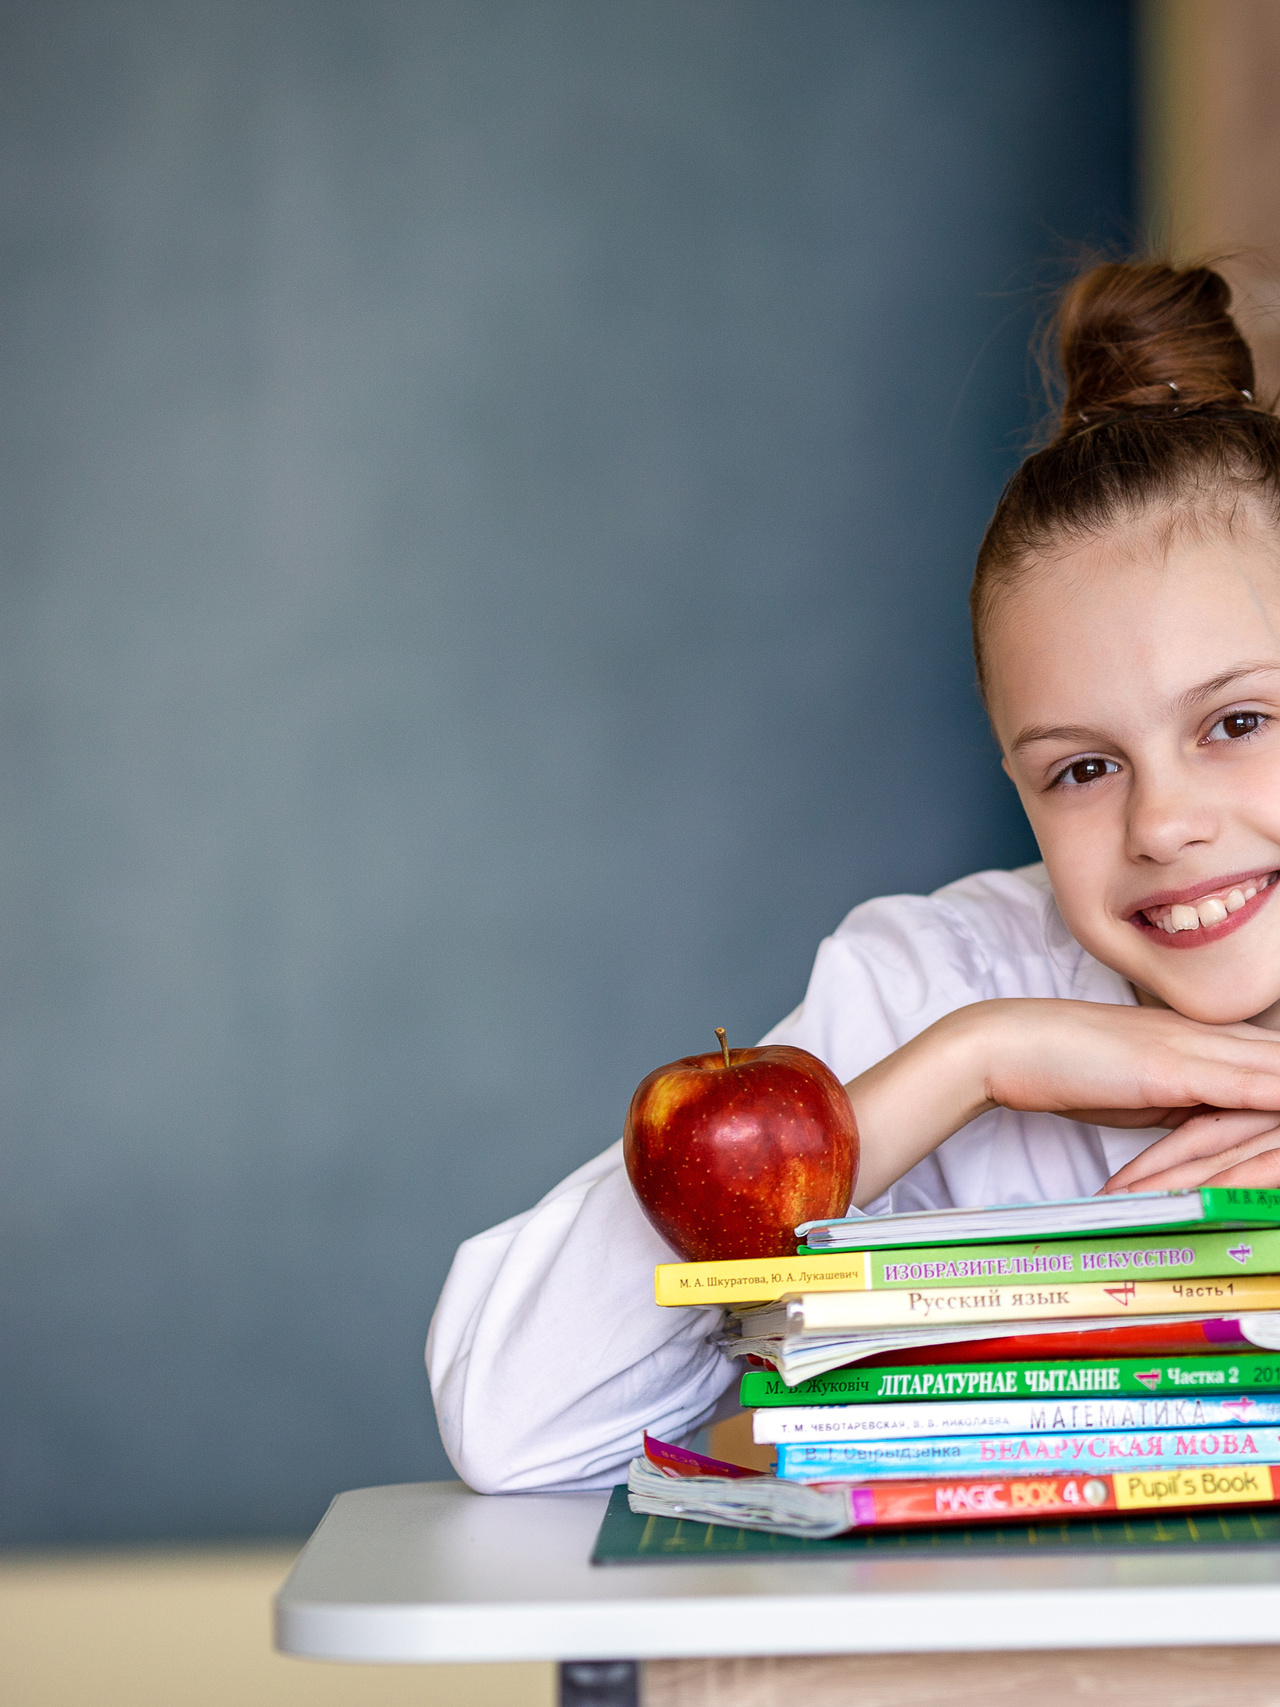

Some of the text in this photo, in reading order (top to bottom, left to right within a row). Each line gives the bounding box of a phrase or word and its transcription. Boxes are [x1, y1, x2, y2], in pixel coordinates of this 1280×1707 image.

[680, 1278, 692, 1288] М.
[694, 1278, 704, 1287] А.
[707, 1275, 768, 1289] Шкуратова,
[771, 1273, 784, 1283] Ю.
[786, 1273, 797, 1282] А.
[799, 1271, 859, 1284] Лукашевич
[884, 1254, 1073, 1282] ИЗОБРАЗИТЕЛЬНОЕ
[1081, 1248, 1195, 1271] ИСКУССТВО
[1227, 1243, 1252, 1265] 4
[908, 1289, 1001, 1317] Русский
[1011, 1291, 1070, 1306] язык
[1103, 1281, 1136, 1307] 4
[765, 1381, 784, 1394] М.
[805, 1377, 869, 1396] Жуковіч
[877, 1371, 1017, 1396] ЛІТАРАТУРНАЕ
[1024, 1368, 1121, 1392] ЧЫТАННЕ
[1134, 1369, 1161, 1390] 4
[1167, 1367, 1225, 1385] Частка
[1228, 1366, 1240, 1384] 2
[1030, 1400, 1206, 1429] МАТЕМАТИКА
[979, 1435, 1163, 1461] БЕЛАРУСКАЯ
[1174, 1434, 1259, 1456] МОВА
[935, 1483, 1008, 1512] MAGIC
[1010, 1481, 1060, 1508] BOX
[1063, 1480, 1081, 1506] 4
[1202, 1471, 1259, 1494] Book
